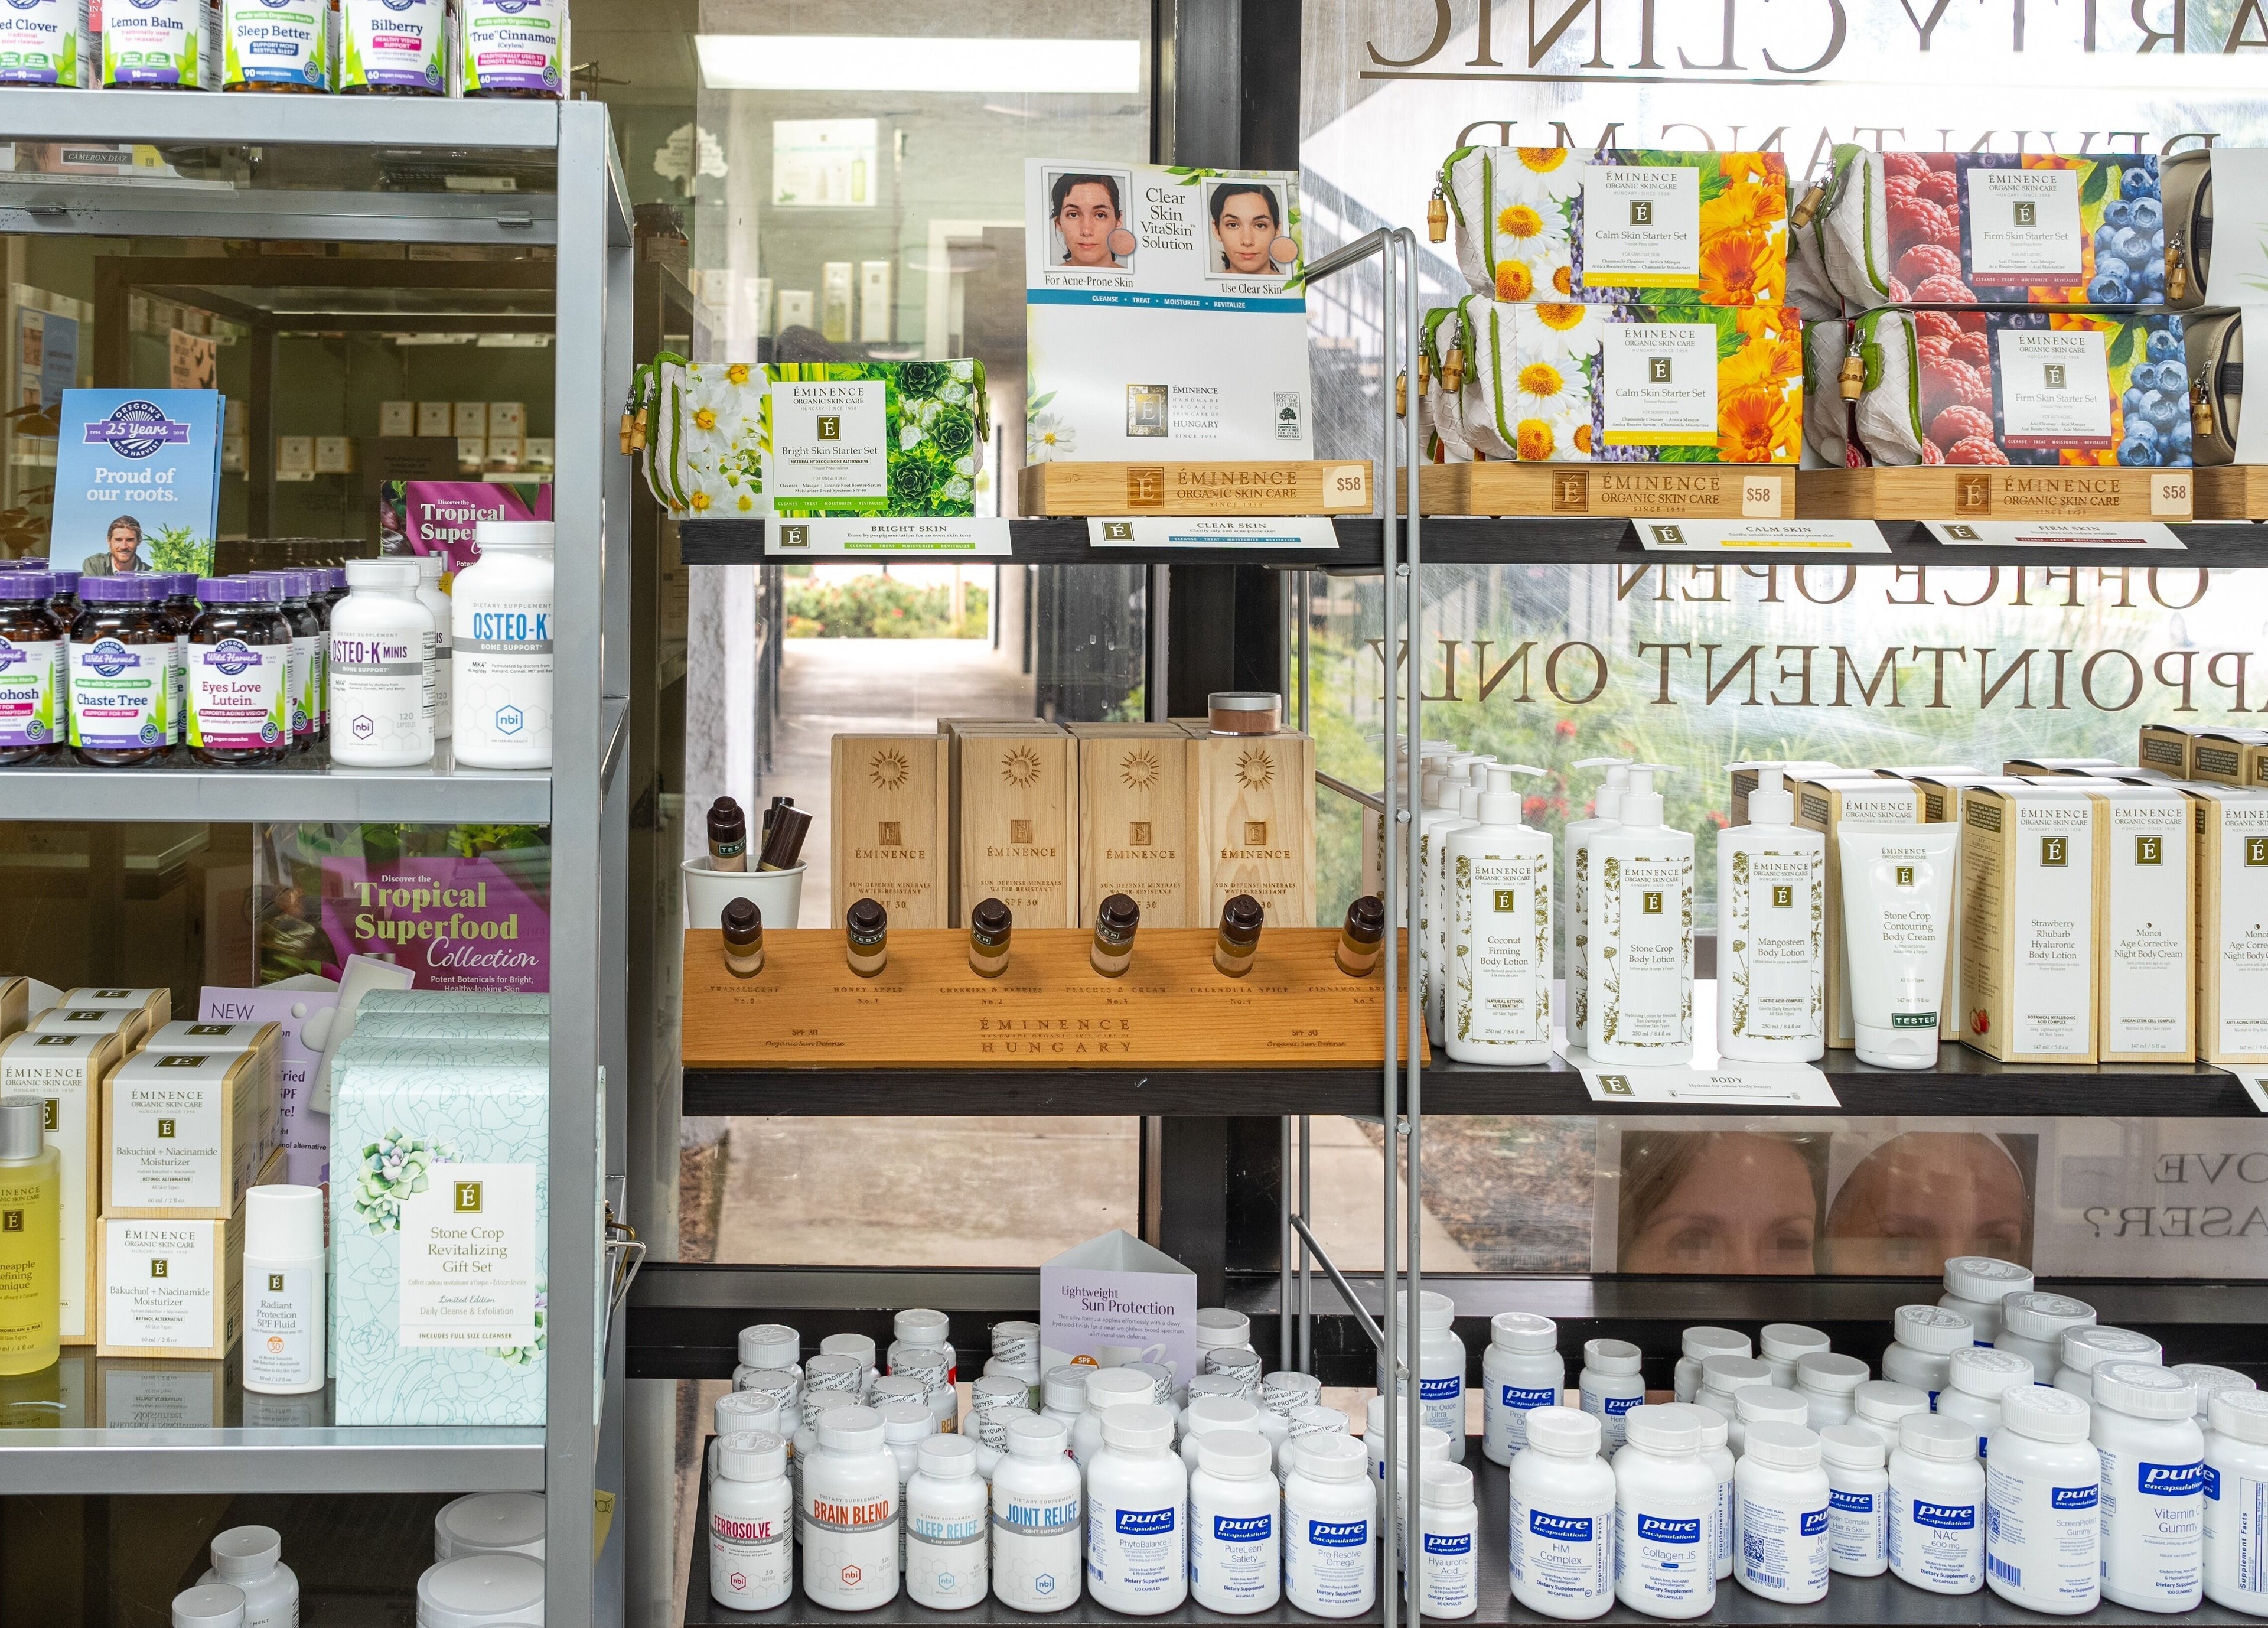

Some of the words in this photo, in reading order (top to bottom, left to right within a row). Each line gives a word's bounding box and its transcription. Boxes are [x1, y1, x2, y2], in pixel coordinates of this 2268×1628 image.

[111, 18, 148, 28] Lemon
[151, 18, 184, 30] Balm
[371, 20, 423, 35] Bilberry
[1146, 187, 1185, 205] Clear
[1151, 204, 1183, 222] Skin
[1596, 230, 1619, 239] Calm
[1621, 231, 1640, 239] Skin
[1643, 232, 1671, 240] Starter
[1673, 231, 1687, 240] Set
[1142, 235, 1194, 250] Solution
[1045, 275, 1060, 285] For
[1062, 276, 1112, 287] Acne-Prone
[1115, 277, 1133, 288] Skin
[1221, 283, 1236, 293] Use
[1239, 284, 1260, 294] Clear
[1263, 285, 1282, 294] Skin
[106, 423, 126, 435] 25
[129, 424, 168, 438] Years
[113, 441, 128, 454] WILD
[131, 442, 159, 456] HARVEST
[782, 447, 809, 457] Bright
[94, 467, 151, 483] Proud
[155, 468, 176, 483] of
[1602, 473, 1720, 490] ÉMINENCE
[1336, 476, 1361, 491] $58
[87, 489, 120, 501] our
[125, 487, 178, 501] roots.
[1746, 488, 1770, 503] $58
[2162, 485, 2186, 499] $58
[383, 646, 407, 659] MINIS
[202, 682, 229, 695] Eyes
[232, 681, 261, 692] Love
[77, 693, 115, 706] Chaste
[118, 695, 148, 706] Tree
[500, 715, 518, 724] nbi
[855, 848, 926, 859] ÉMINENCE
[382, 875, 416, 883] Discover
[418, 875, 431, 883] the
[354, 881, 487, 913] Tropical
[354, 913, 519, 946] Superfood
[2031, 920, 2075, 929] Strawberry
[852, 929, 887, 943] TESTE
[1488, 936, 1521, 945] Coconut
[2036, 930, 2070, 939] Rhubarb
[1758, 937, 1805, 949] Mangosteen
[2031, 940, 2075, 949] Hyaluronic
[2120, 940, 2136, 949] Age
[426, 936, 538, 969] Collection
[1488, 946, 1521, 958] Firming
[2114, 950, 2136, 959] Night
[2138, 950, 2156, 959] Body
[1481, 957, 1501, 968] Body
[510, 976, 533, 985] Bright,
[210, 1003, 255, 1020] NEW
[131, 1089, 203, 1099] ÉMINENCE
[116, 1147, 155, 1156] Bakuchiol
[166, 1147, 217, 1156] Niacinamide
[141, 1157, 190, 1166] Moisturizer
[431, 1227, 467, 1239] Stone
[471, 1227, 504, 1242] Crop
[428, 1243, 507, 1259] Revitalizing
[442, 1261, 468, 1272] Gift
[472, 1261, 492, 1272] Set
[260, 1300, 292, 1310] Radiant
[421, 1307, 437, 1316] Daily
[1082, 1300, 1104, 1312] Sun
[1109, 1301, 1175, 1316] Protection
[271, 1343, 281, 1351] 30
[814, 1500, 849, 1523] BRAIN
[853, 1500, 889, 1524] BLEND
[1006, 1503, 1041, 1525] JOINT
[1045, 1500, 1077, 1527] RELIEF
[1122, 1512, 1171, 1525] pure
[1643, 1519, 1696, 1532] pure
[1934, 1529, 1958, 1541] NAC
[1553, 1544, 1569, 1554] HM
[1643, 1547, 1683, 1561] Collagen
[1687, 1551, 1696, 1559] JS
[1428, 1557, 1468, 1567] Hyaluronic
[1540, 1551, 1582, 1565] Complex
